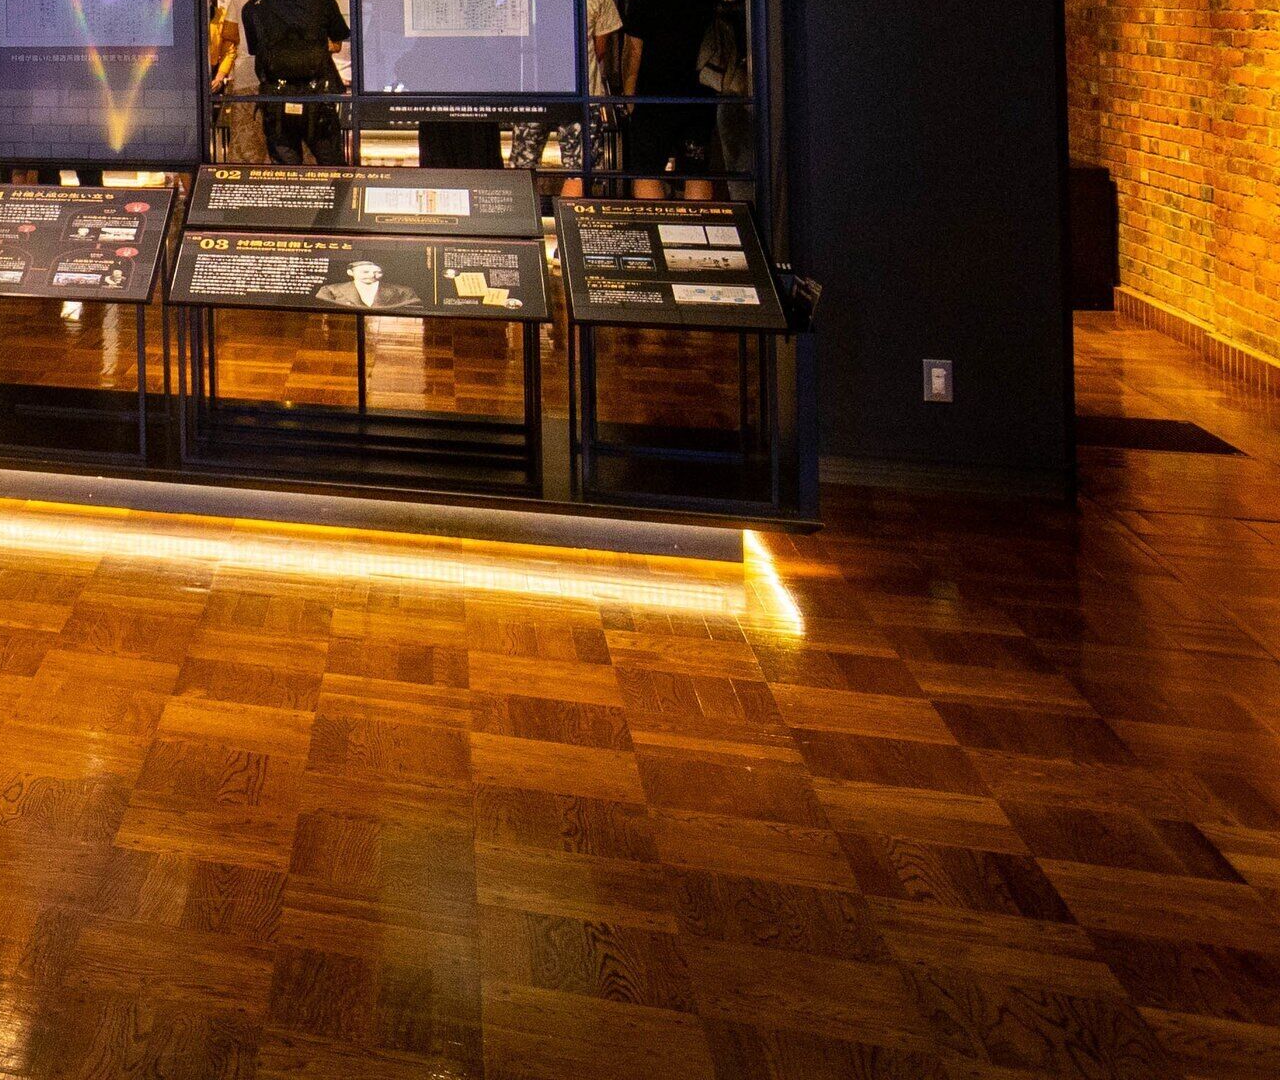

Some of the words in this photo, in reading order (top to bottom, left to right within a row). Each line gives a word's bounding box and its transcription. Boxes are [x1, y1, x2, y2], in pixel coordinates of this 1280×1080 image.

[215, 170, 242, 180] 02
[573, 205, 596, 214] 04
[200, 238, 229, 250] 03
